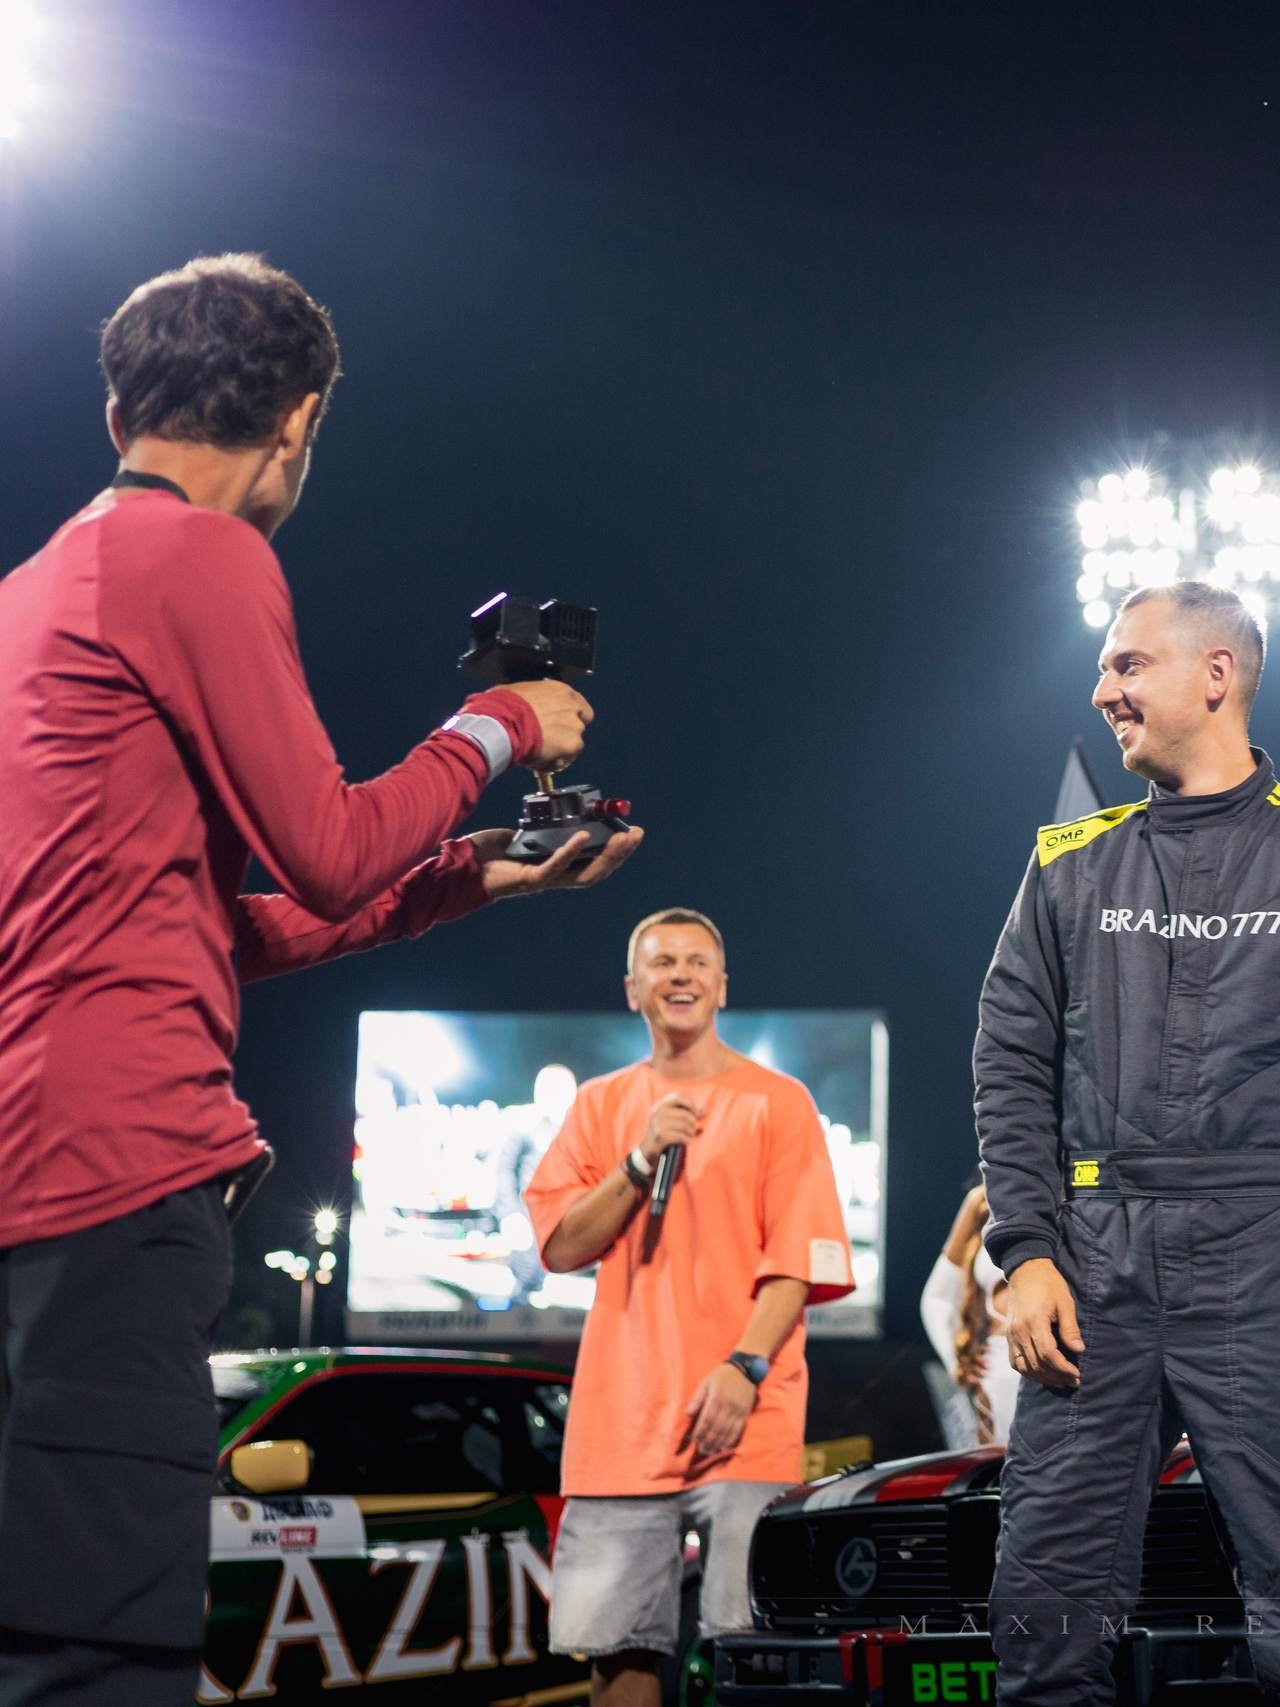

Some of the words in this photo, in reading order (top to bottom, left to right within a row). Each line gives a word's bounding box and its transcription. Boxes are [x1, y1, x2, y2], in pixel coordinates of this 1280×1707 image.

[1046, 829, 1084, 847] OMP
[1074, 1165, 1100, 1182] OMP
[196, 1532, 553, 1704] AZIN
